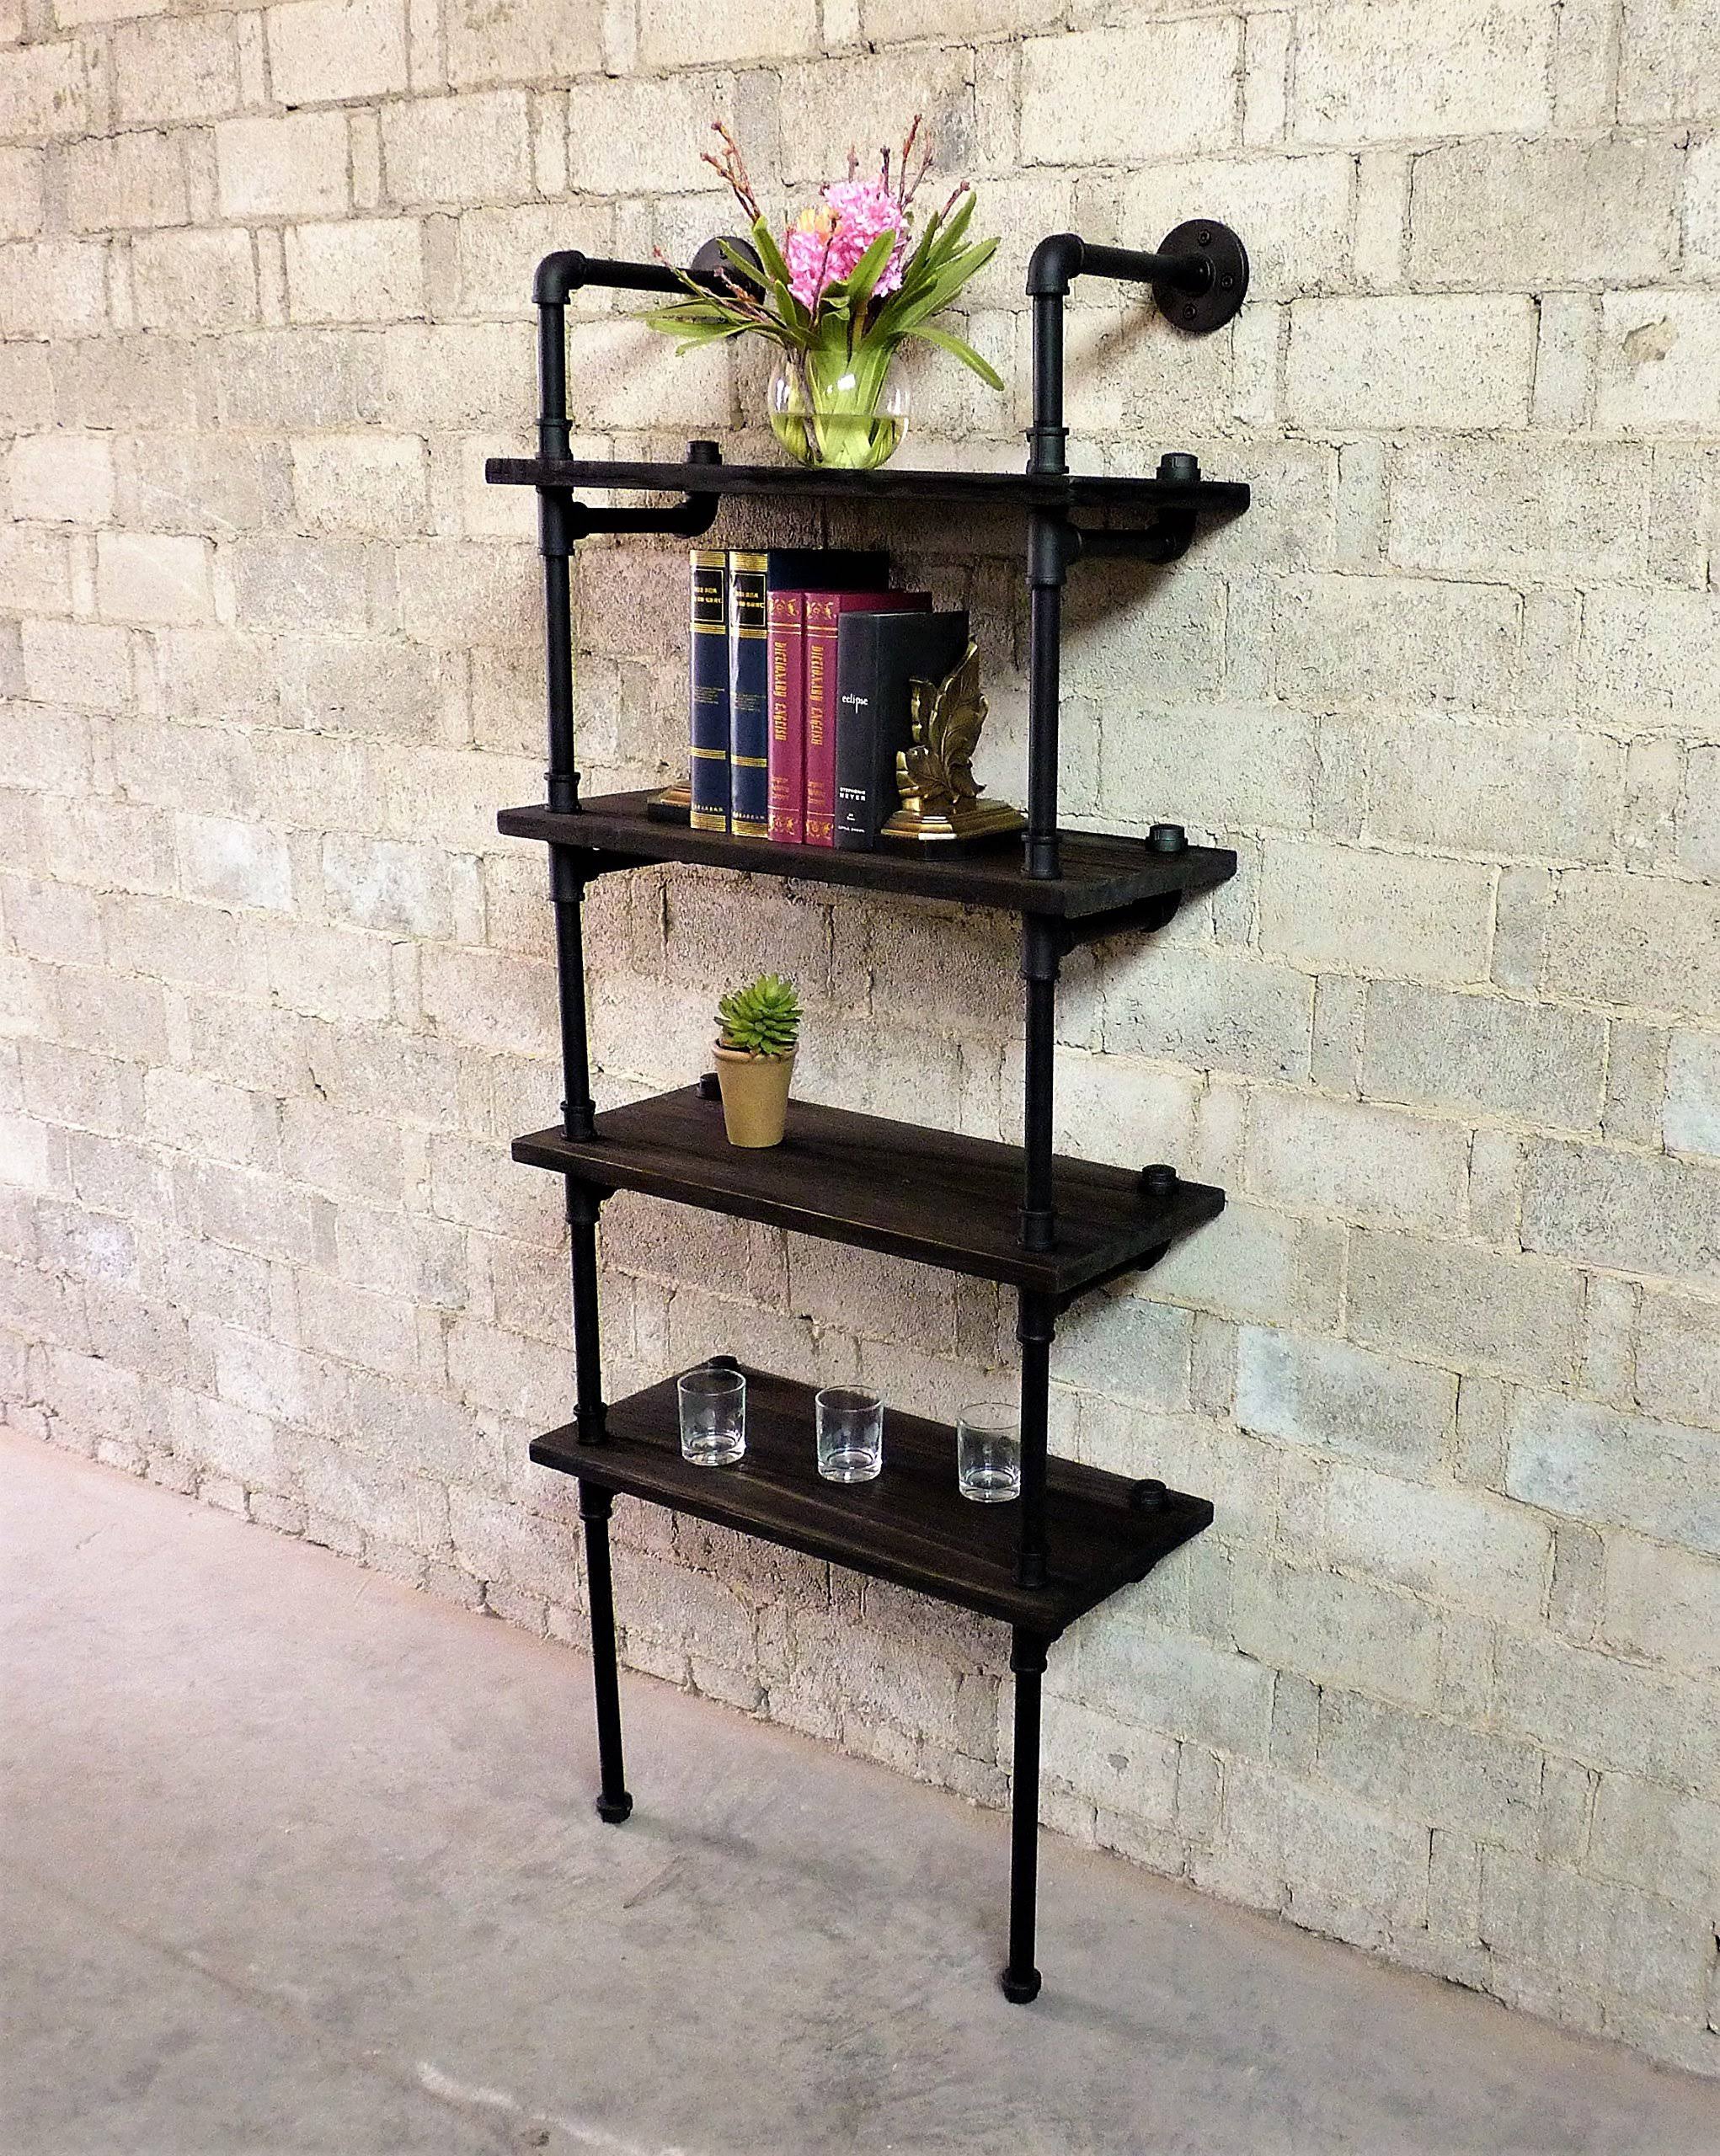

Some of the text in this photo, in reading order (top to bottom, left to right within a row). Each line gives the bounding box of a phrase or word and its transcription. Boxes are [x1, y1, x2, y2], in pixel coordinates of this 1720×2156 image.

[774, 702, 787, 741] ENGLISH
[842, 694, 868, 714] eclipse
[809, 707, 823, 746] ENGLISH
